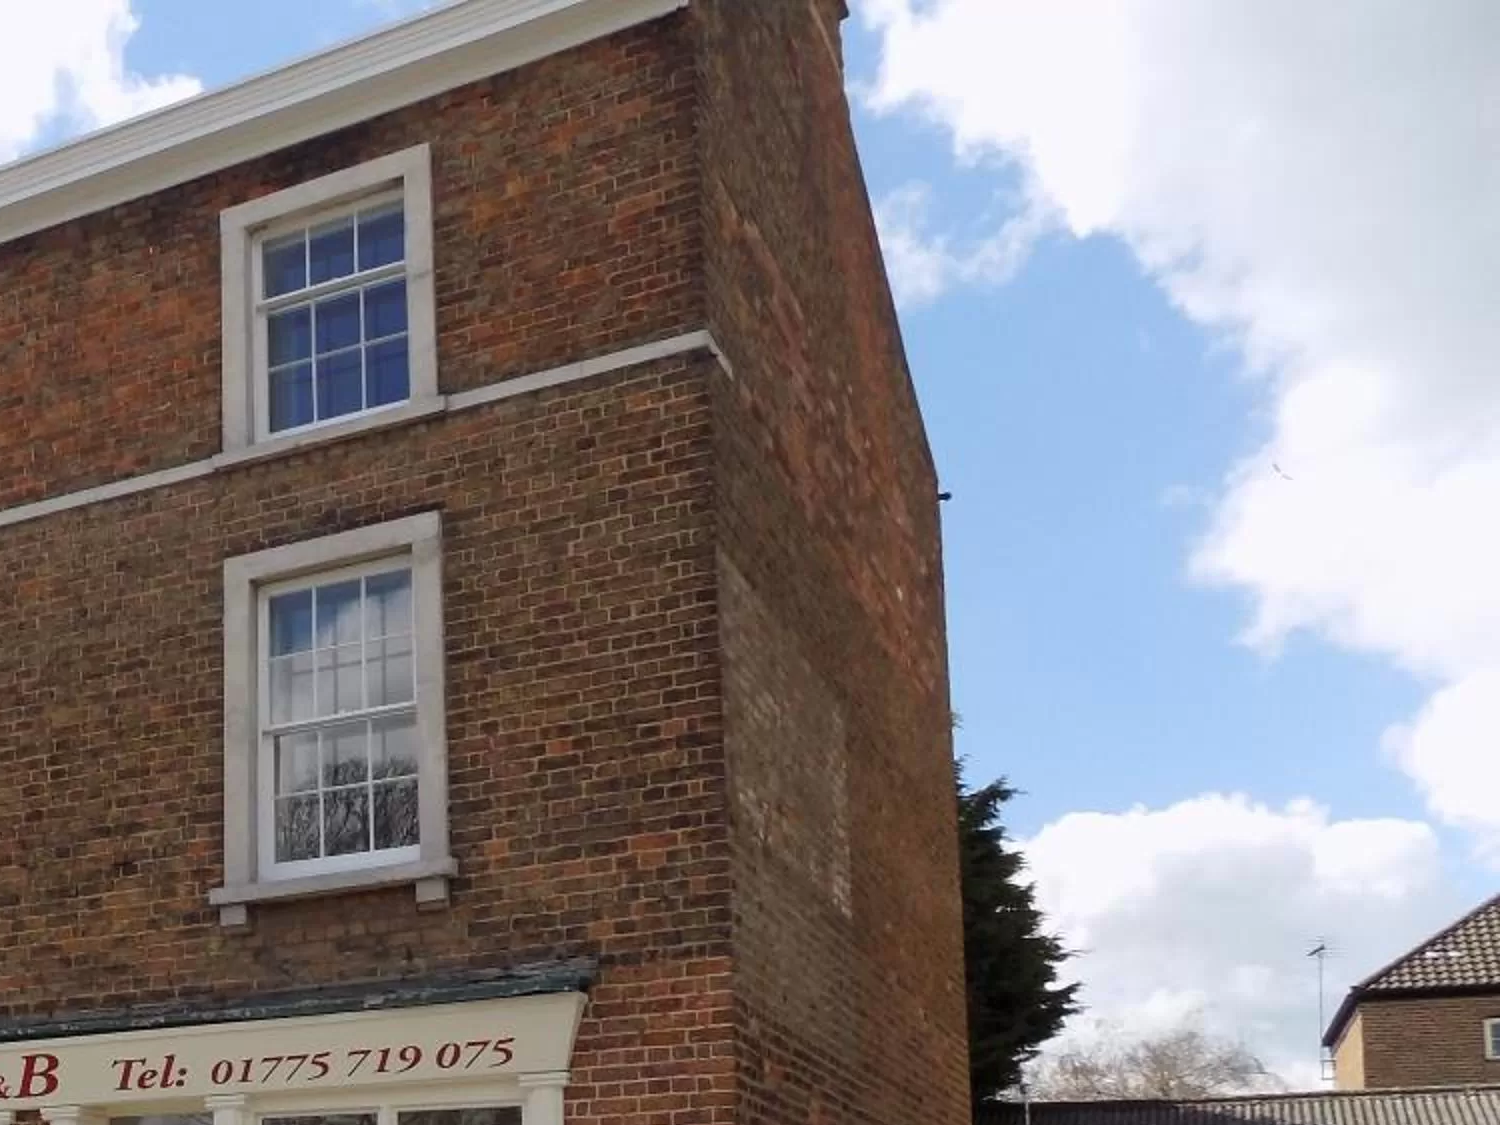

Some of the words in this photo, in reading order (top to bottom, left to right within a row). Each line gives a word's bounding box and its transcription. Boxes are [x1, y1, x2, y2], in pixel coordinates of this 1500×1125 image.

[112, 1054, 187, 1092] Tel:
[211, 1051, 332, 1086] 01775
[347, 1045, 422, 1077] 719
[436, 1037, 516, 1070] 075
